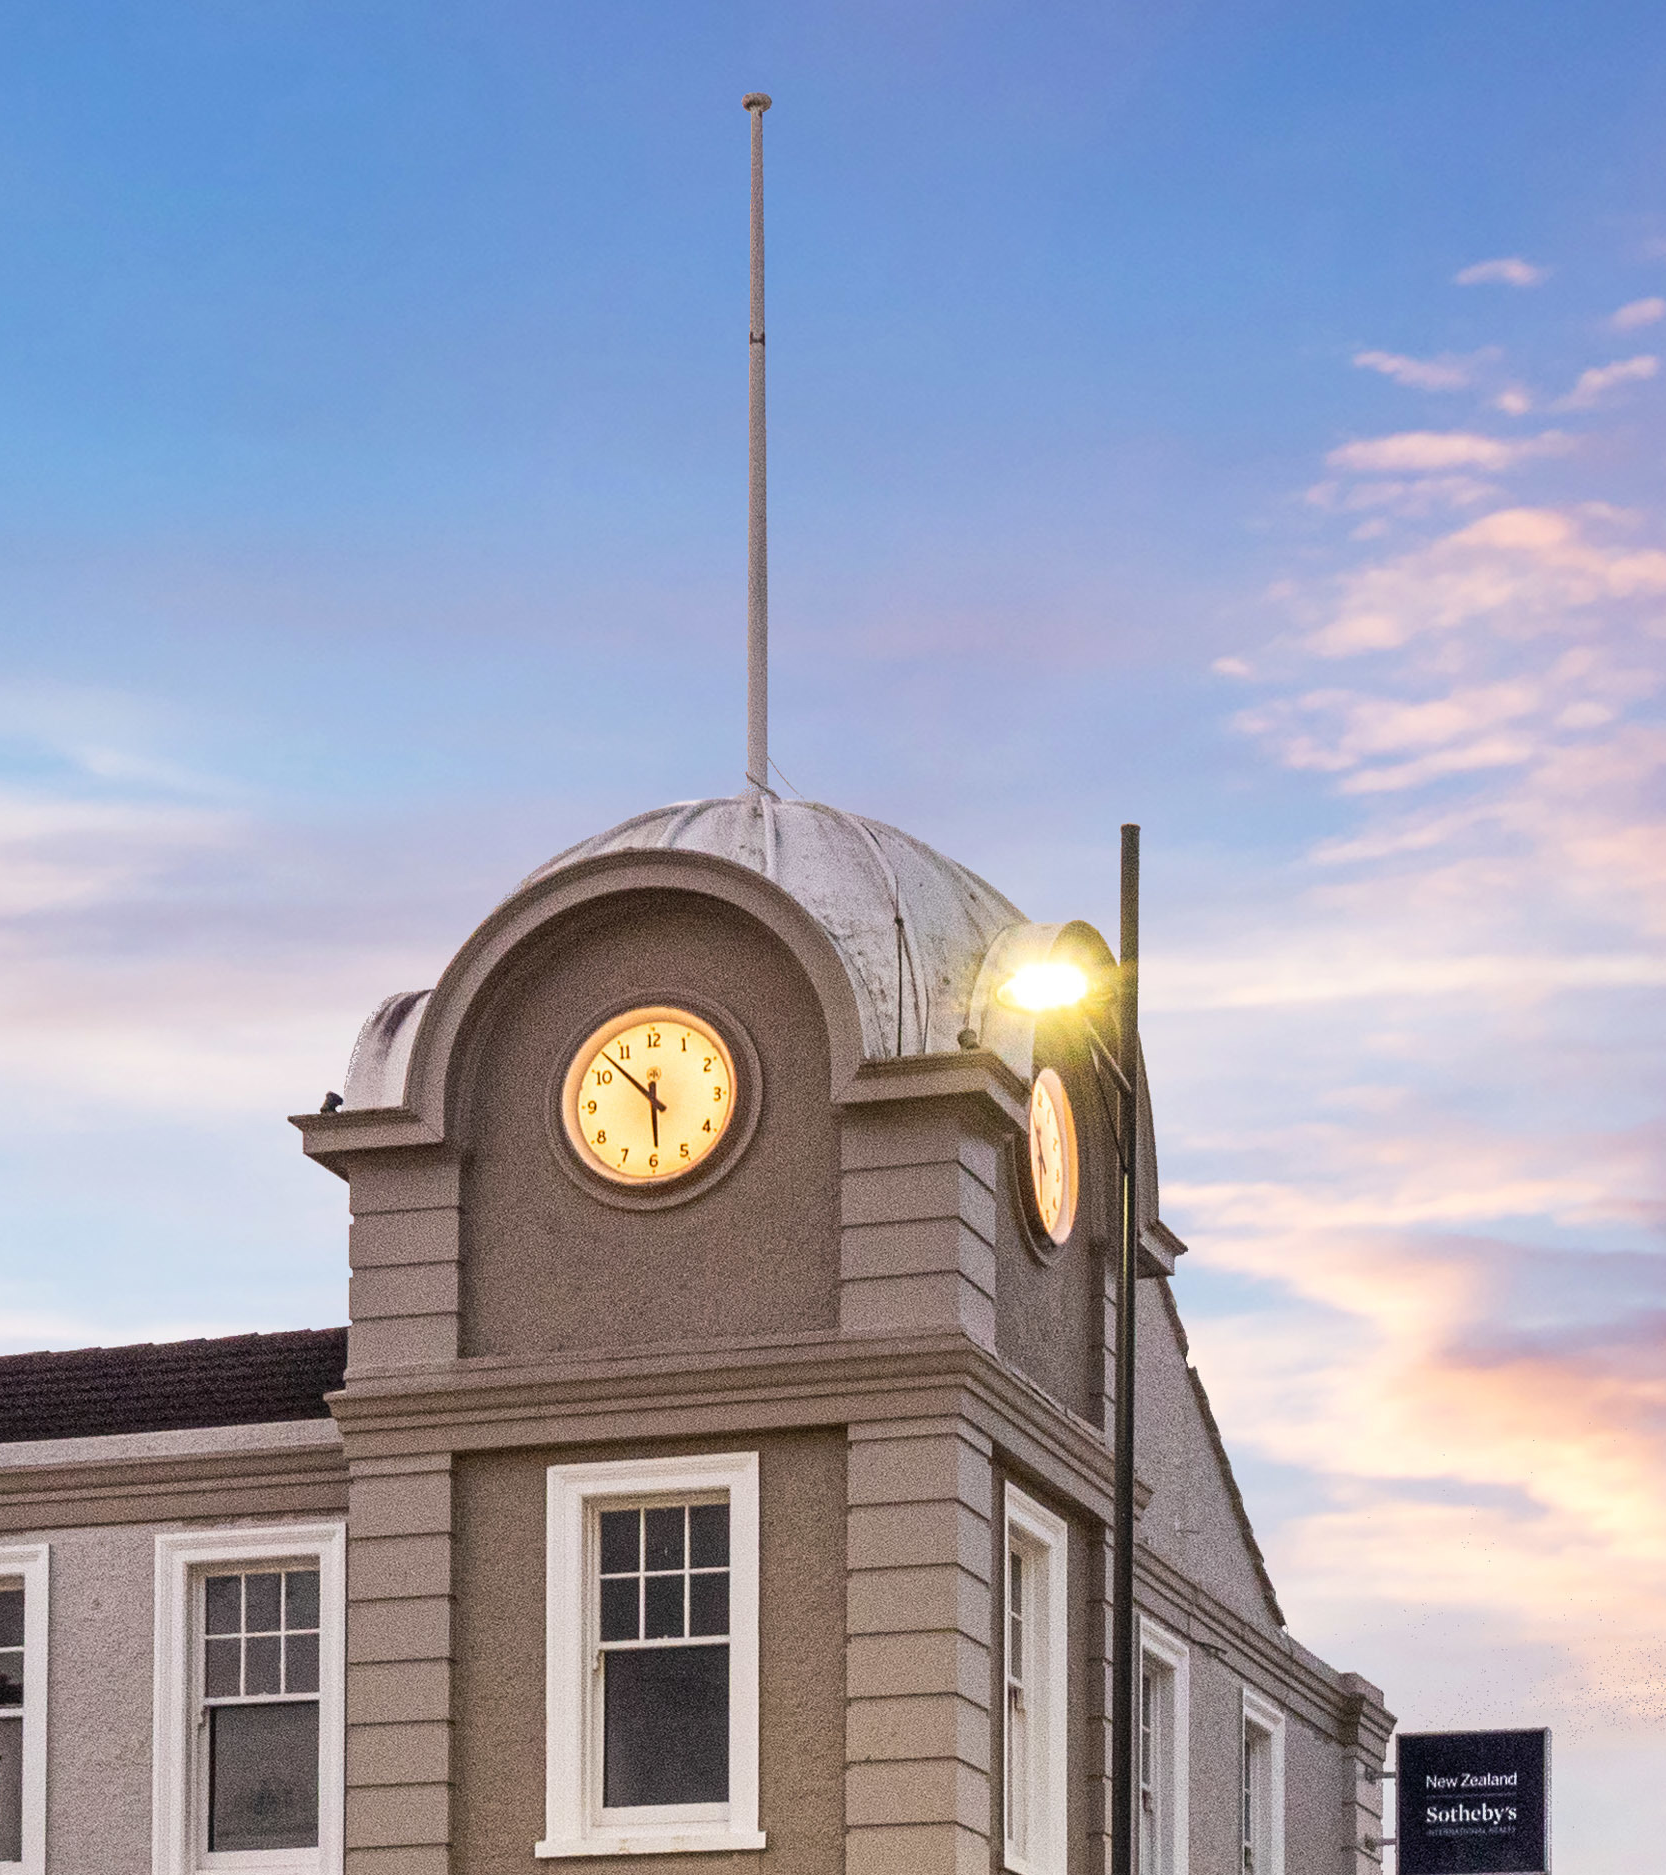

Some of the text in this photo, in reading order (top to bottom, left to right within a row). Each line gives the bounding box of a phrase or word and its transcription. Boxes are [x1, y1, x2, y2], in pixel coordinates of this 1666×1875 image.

[647, 1033, 661, 1048] 12
[681, 1037, 687, 1051] 1
[620, 1045, 631, 1060] 11
[703, 1057, 712, 1072] 2
[596, 1070, 613, 1086] 10
[713, 1086, 722, 1101] 3
[587, 1100, 597, 1114] 9
[701, 1119, 711, 1133] 4
[596, 1130, 607, 1144] 8
[620, 1148, 629, 1163] 7
[679, 1143, 689, 1158] 5
[648, 1153, 659, 1168] 6
[1426, 1771, 1518, 1789] New Zealand
[1426, 1803, 1517, 1825] Sotheby's
